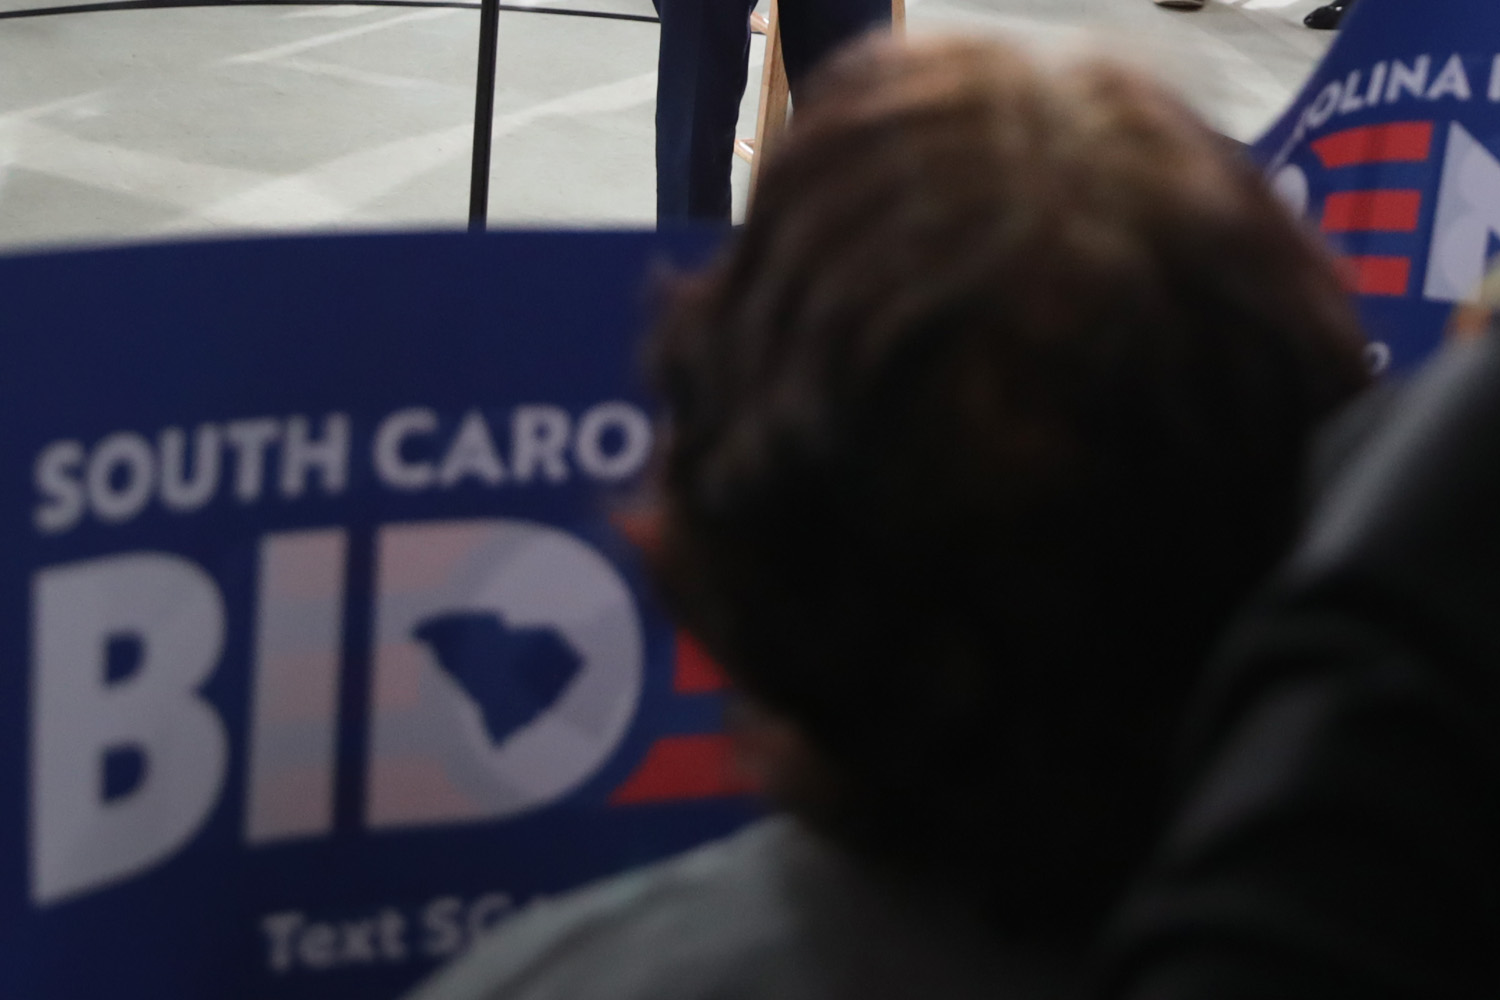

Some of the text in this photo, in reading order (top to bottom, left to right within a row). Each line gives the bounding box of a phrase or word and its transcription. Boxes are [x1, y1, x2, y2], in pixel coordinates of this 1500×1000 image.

[33, 401, 655, 533] SOUTH CARO
[30, 516, 760, 908] BID
[263, 909, 405, 972] Text
